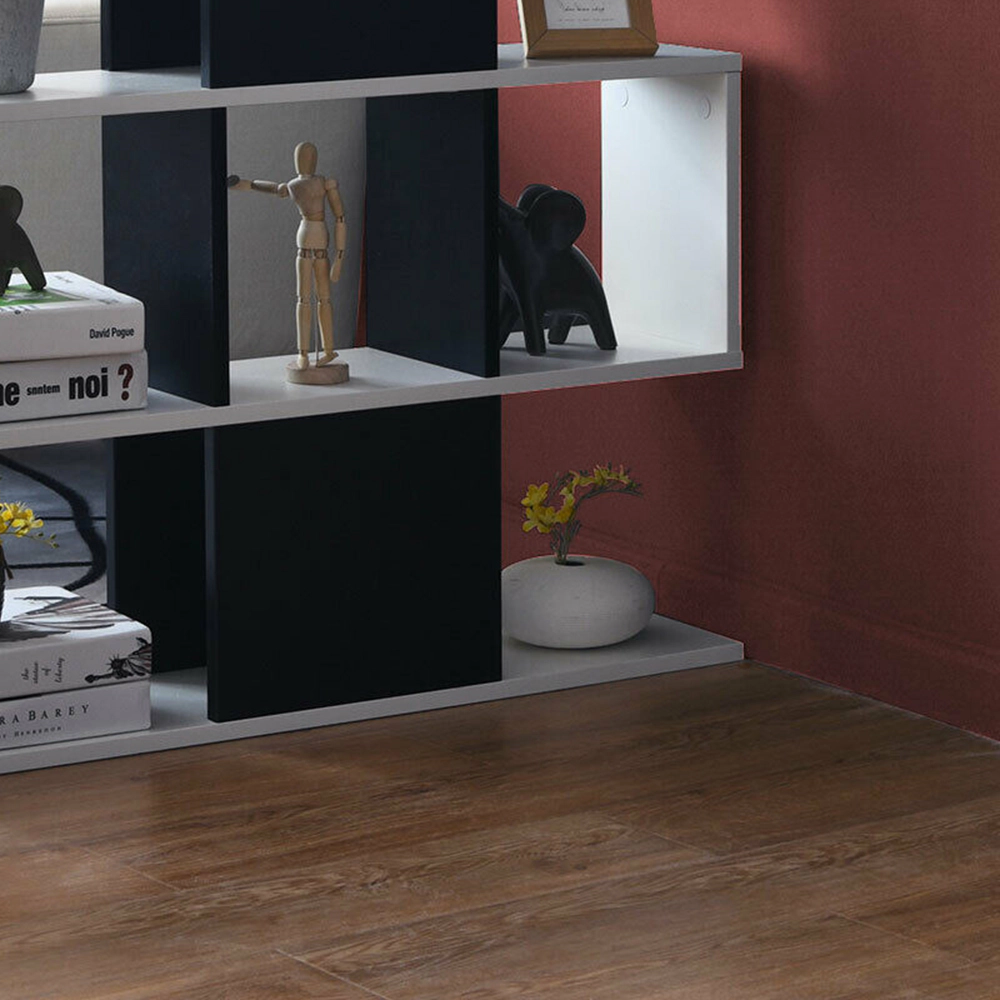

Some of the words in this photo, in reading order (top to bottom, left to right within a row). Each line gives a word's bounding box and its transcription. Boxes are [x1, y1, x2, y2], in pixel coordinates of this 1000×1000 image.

[89, 327, 110, 339] David
[111, 326, 135, 339] Pogue
[68, 367, 109, 399] noi
[117, 363, 134, 401] ?
[28, 703, 90, 721] BAREY
